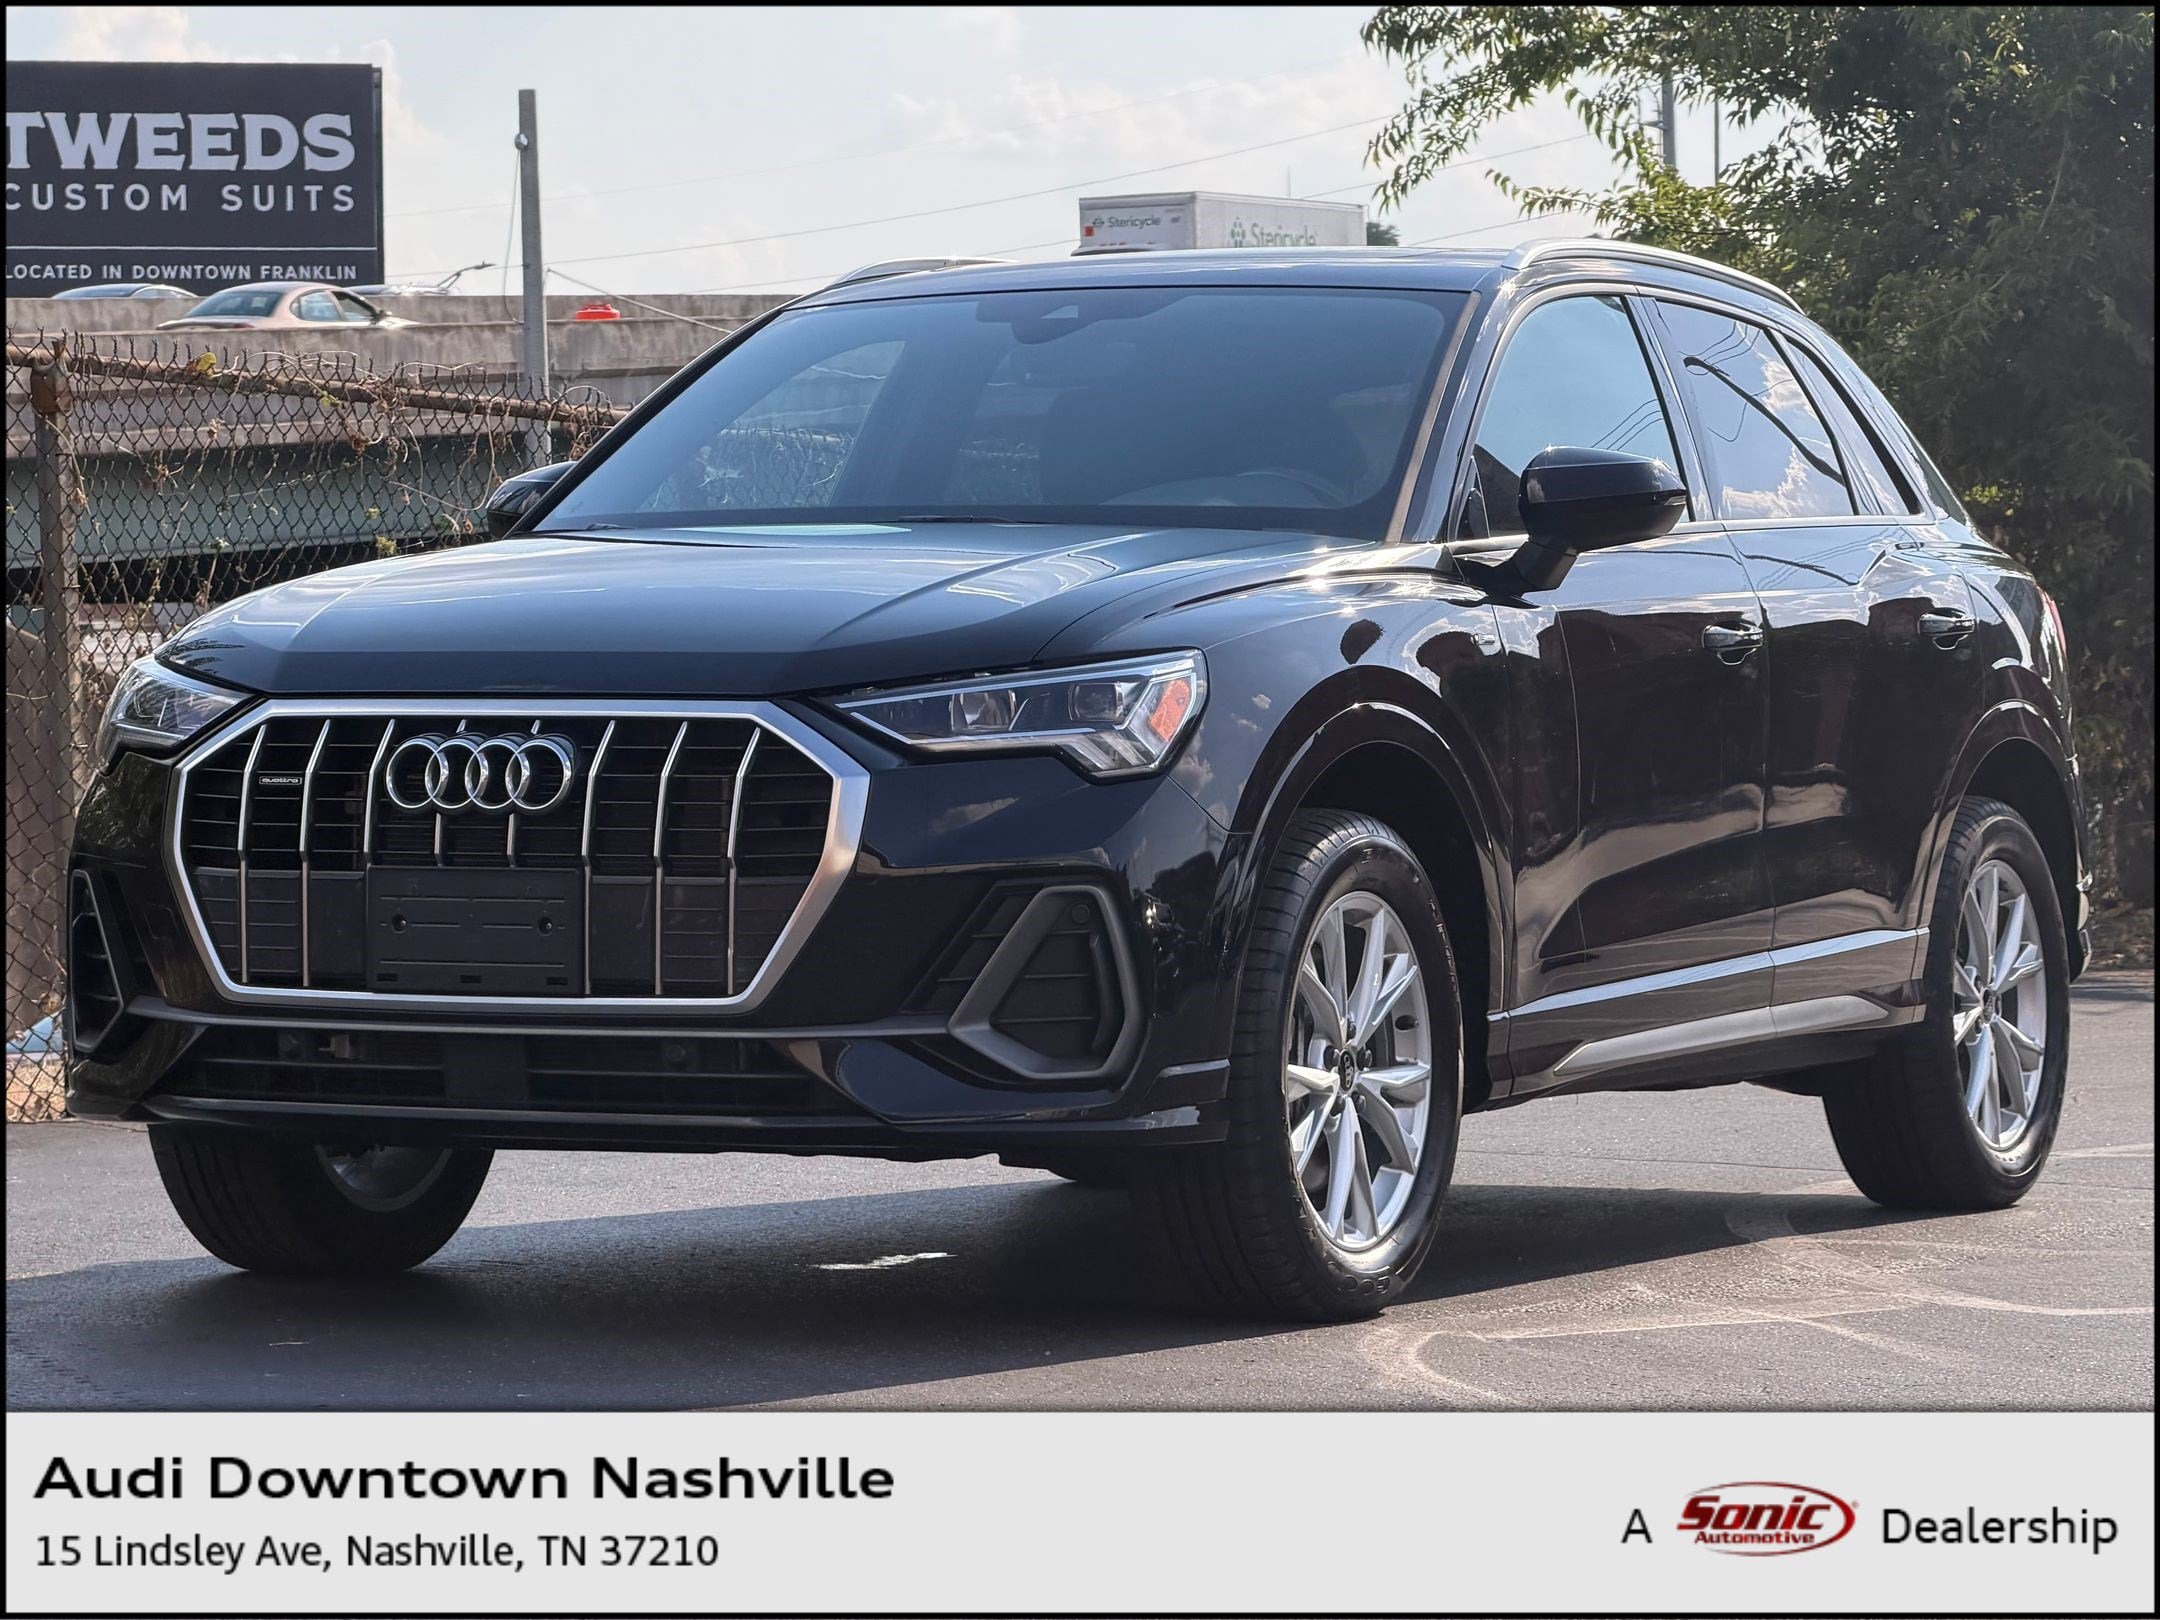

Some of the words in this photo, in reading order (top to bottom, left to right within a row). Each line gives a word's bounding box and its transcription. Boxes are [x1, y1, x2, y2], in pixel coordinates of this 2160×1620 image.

[6, 112, 355, 171] TWEEDS
[6, 183, 187, 211] CUSTOM
[222, 185, 354, 212] SUITS
[103, 265, 121, 279] IN
[133, 265, 251, 280] DOWNTOWN
[261, 265, 356, 280] FRANKLIN
